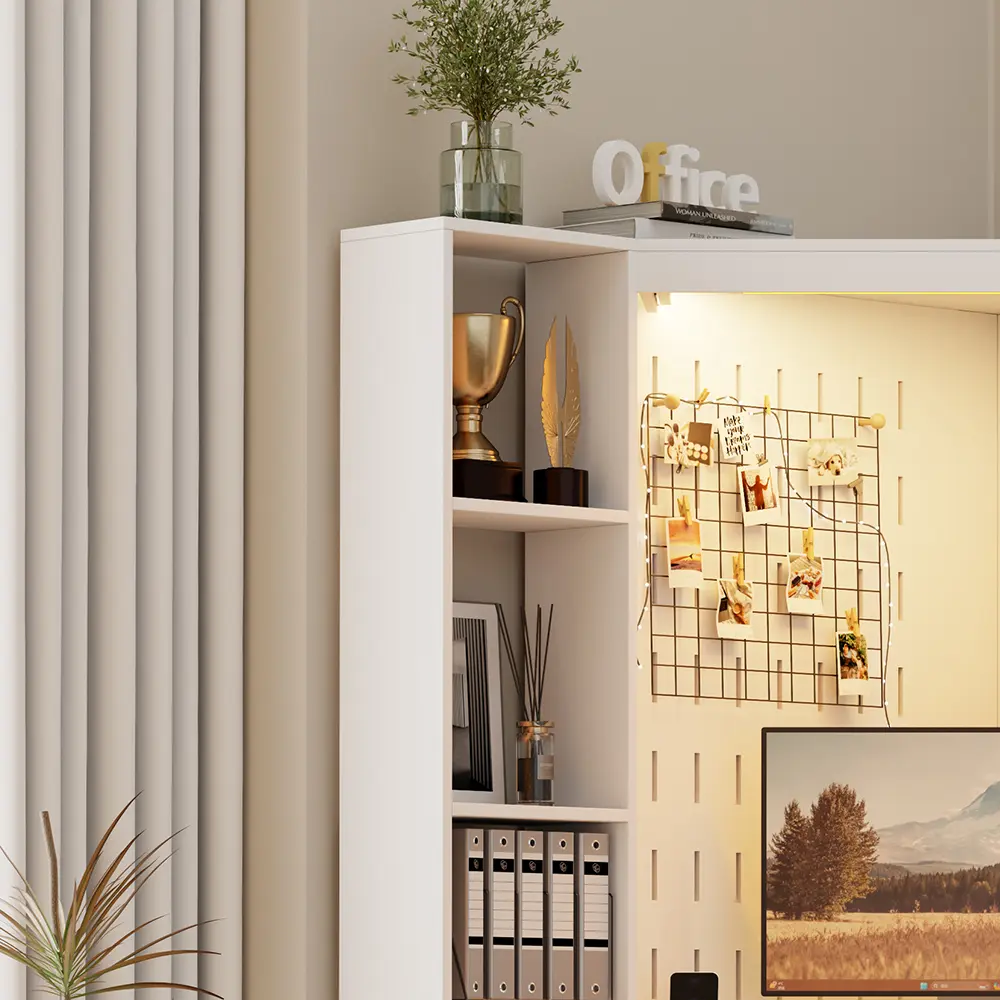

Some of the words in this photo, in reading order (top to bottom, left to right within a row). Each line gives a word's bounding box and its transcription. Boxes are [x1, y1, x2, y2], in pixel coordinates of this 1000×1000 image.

[592, 139, 759, 213] Office
[675, 208, 701, 217] WOMAN
[702, 211, 737, 221] UNLEASHED
